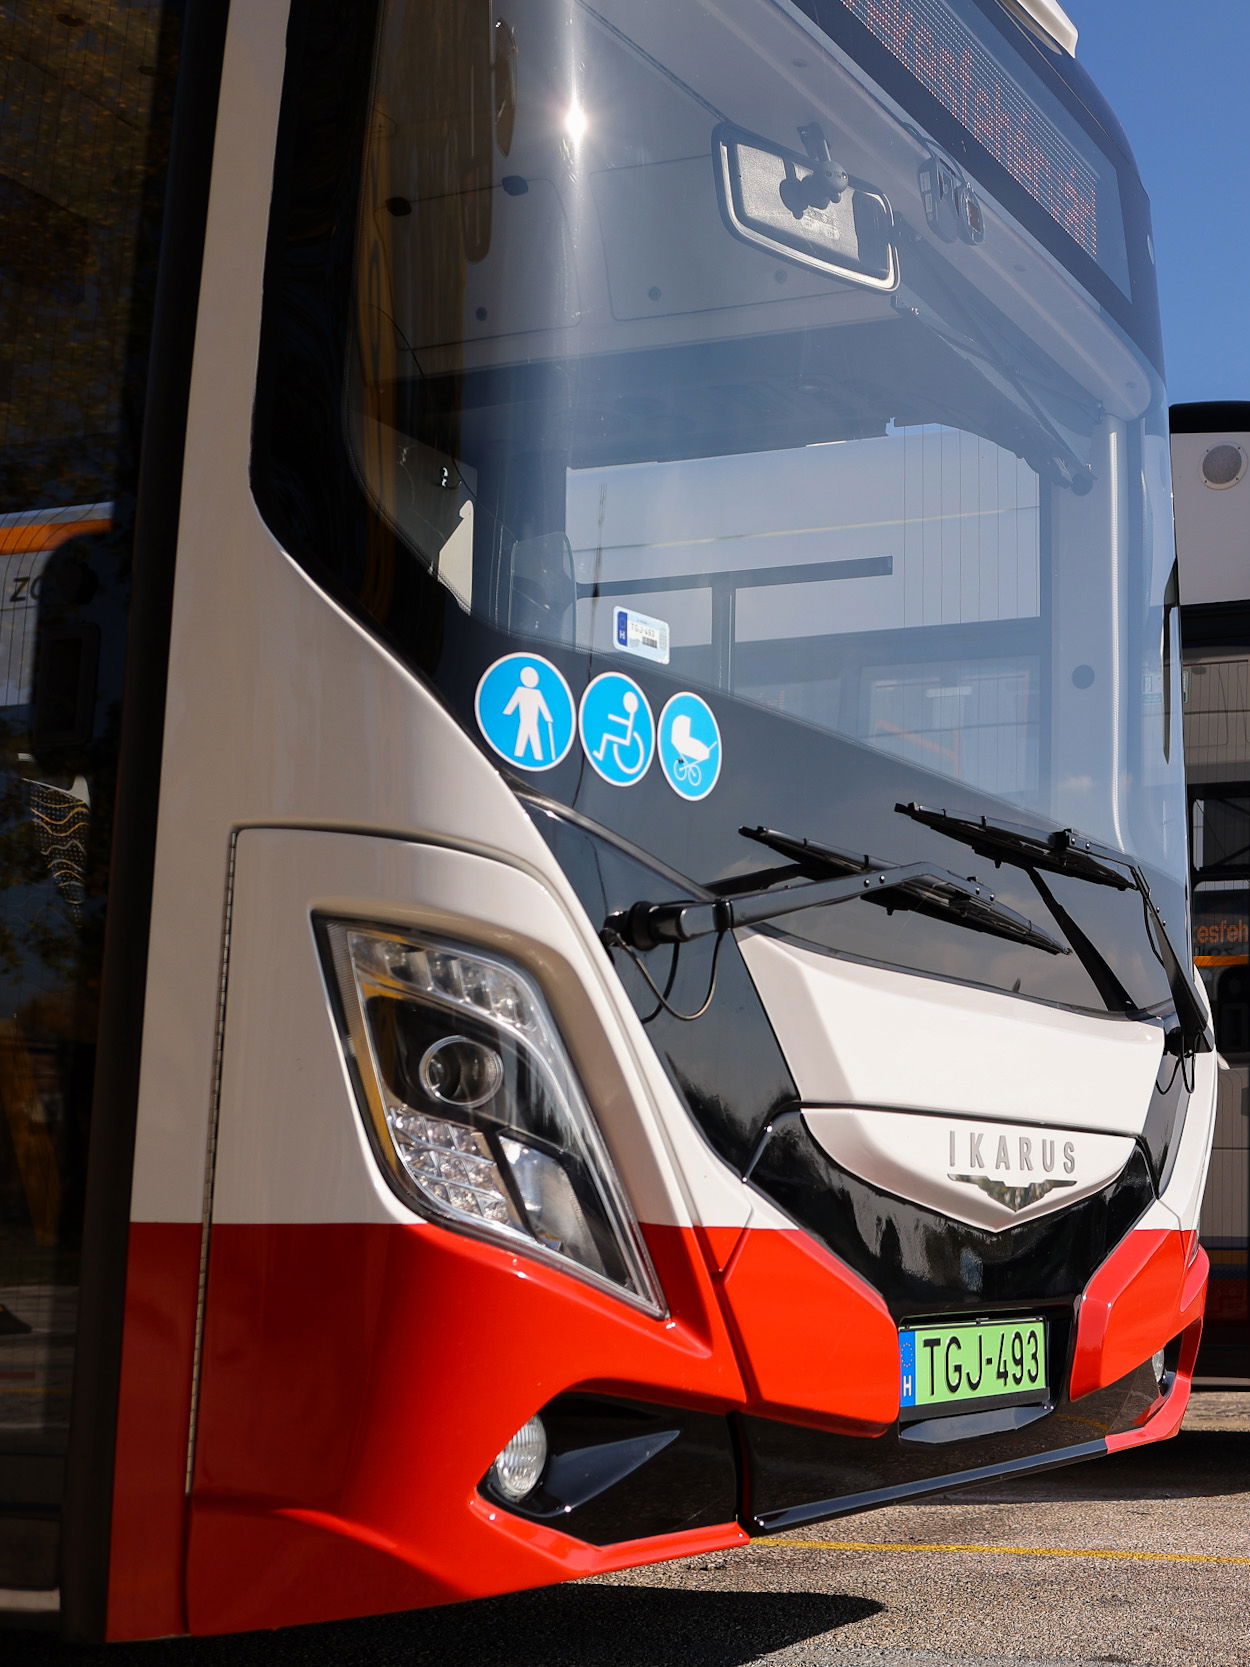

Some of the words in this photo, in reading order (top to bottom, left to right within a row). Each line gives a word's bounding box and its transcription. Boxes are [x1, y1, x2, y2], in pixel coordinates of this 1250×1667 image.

[949, 1130, 1076, 1175] IKARUS
[903, 1375, 912, 1397] H
[923, 1330, 1039, 1396] TGJ-493
